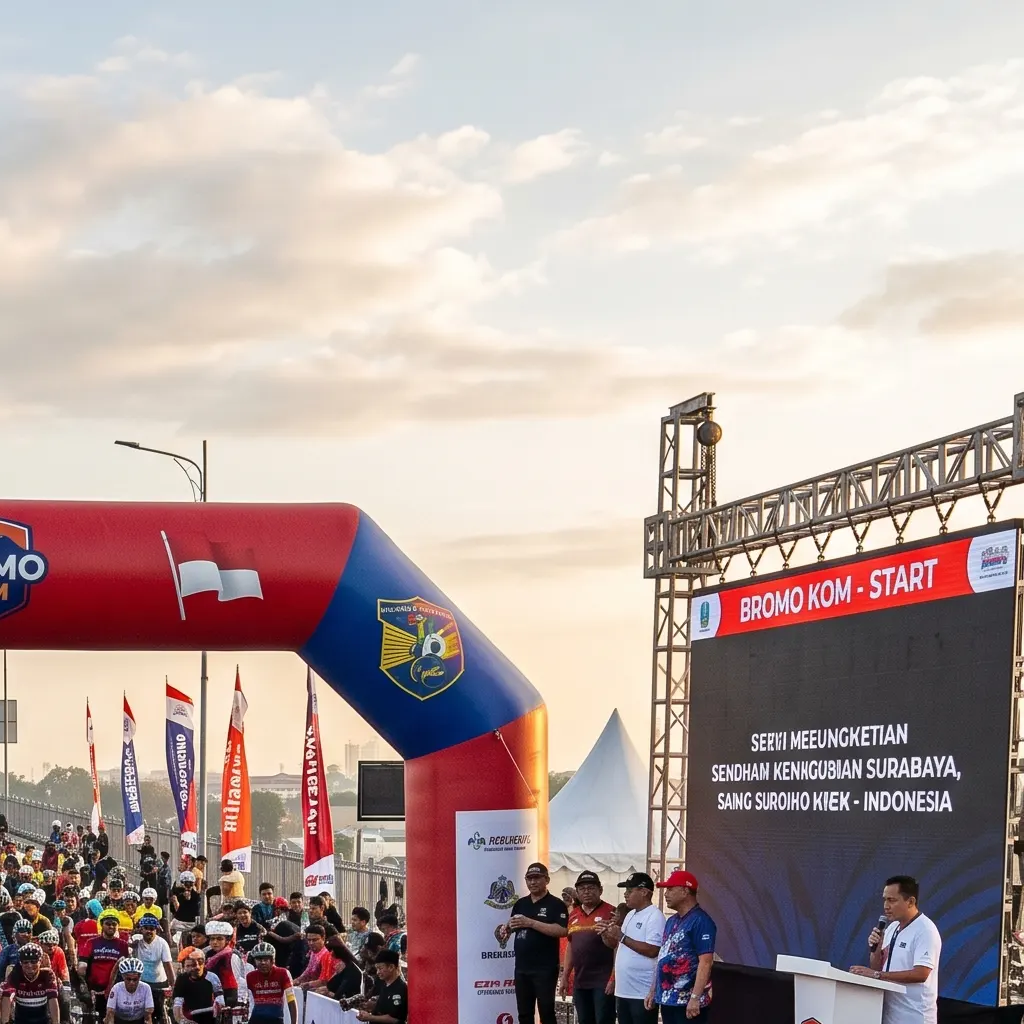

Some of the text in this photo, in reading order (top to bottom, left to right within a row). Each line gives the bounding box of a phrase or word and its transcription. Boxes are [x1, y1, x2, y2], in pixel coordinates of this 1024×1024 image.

[740, 586, 804, 623] BROMO
[808, 575, 852, 611] KOM
[869, 558, 939, 600] START
[866, 755, 962, 782] SURABAYA,
[863, 790, 953, 813] INDONESIA
